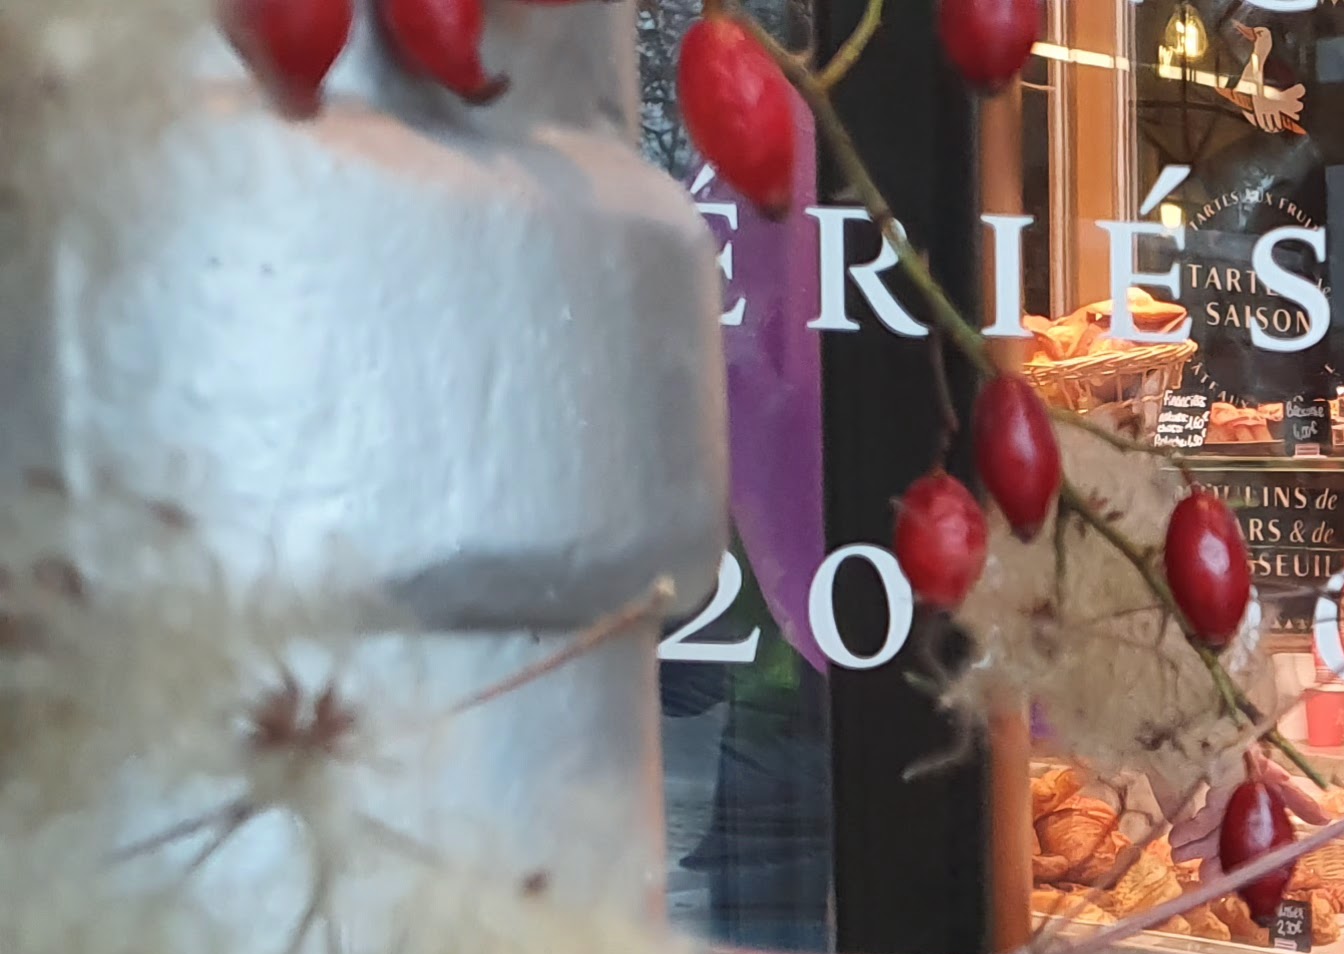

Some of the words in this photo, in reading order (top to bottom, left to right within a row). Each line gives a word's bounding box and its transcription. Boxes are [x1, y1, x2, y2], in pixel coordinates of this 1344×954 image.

[1315, 487, 1338, 511] de
[1289, 519, 1305, 544] &
[1311, 520, 1335, 544] de
